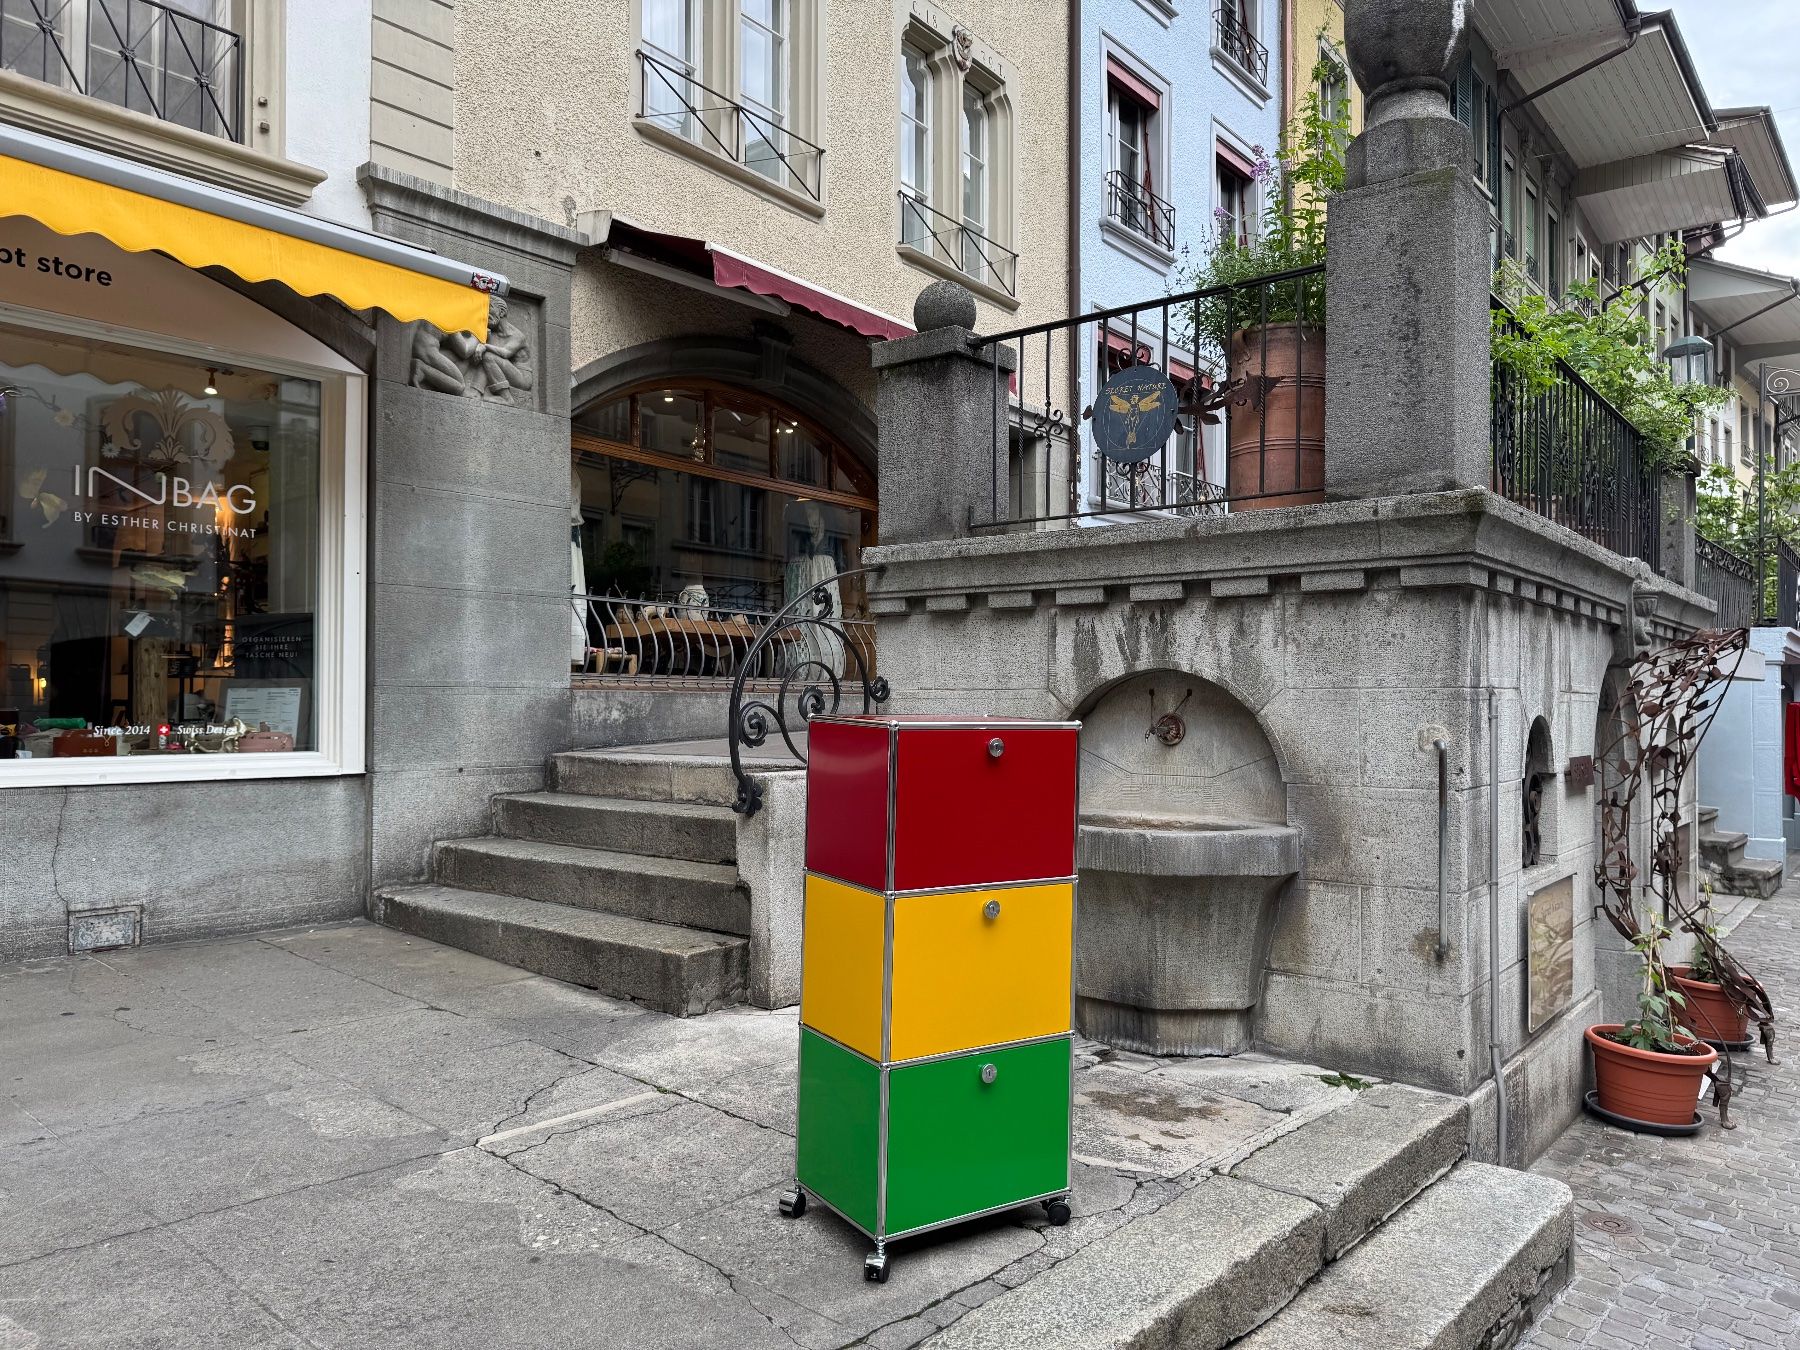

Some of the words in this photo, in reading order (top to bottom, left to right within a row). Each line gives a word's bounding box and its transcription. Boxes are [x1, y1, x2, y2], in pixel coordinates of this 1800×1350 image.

[37, 256, 113, 287] store
[74, 464, 257, 515] INBAG
[74, 511, 93, 523] BY
[101, 514, 160, 530] ESTHER
[167, 520, 257, 539] CHRISTINAT
[93, 725, 124, 736] Since
[125, 725, 151, 735] 2014
[177, 725, 204, 736] Swiss
